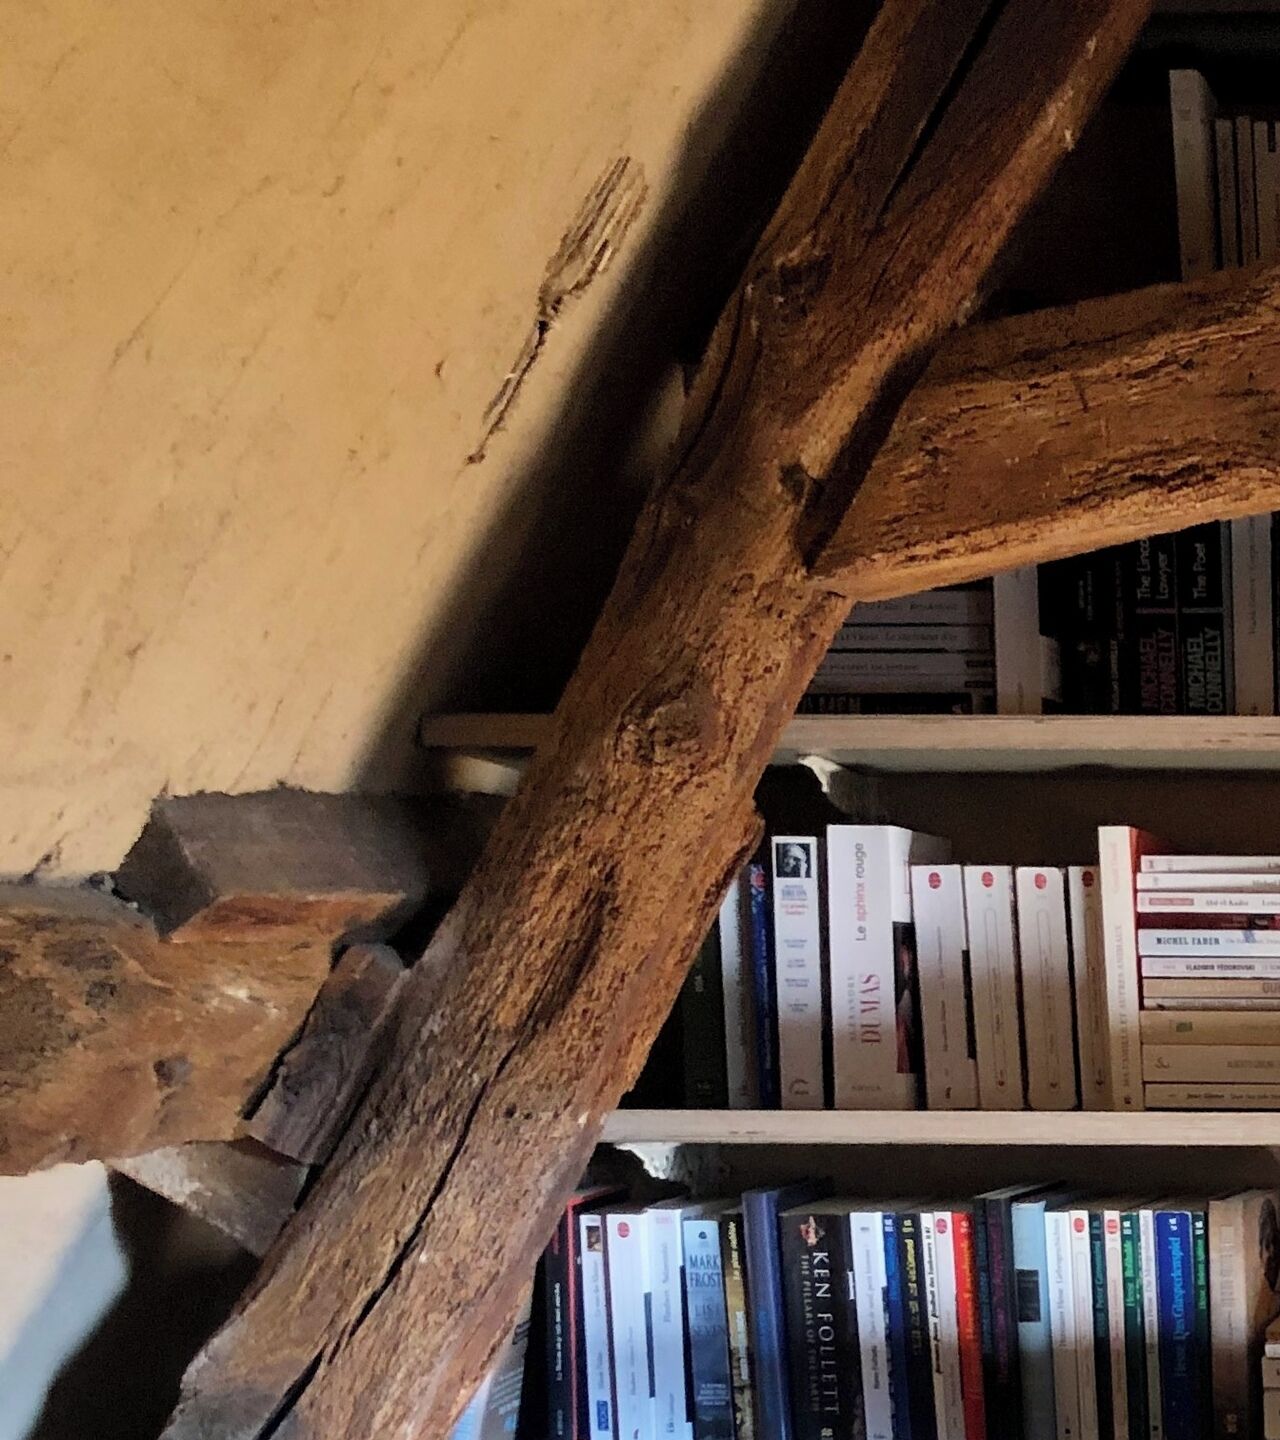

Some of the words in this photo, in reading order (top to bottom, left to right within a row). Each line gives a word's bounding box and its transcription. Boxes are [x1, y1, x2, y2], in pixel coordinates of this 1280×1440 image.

[1154, 552, 1171, 600] Lawyer
[1192, 576, 1207, 599] The
[1186, 633, 1206, 708] MICHAEL
[1203, 627, 1224, 712] CONNELLY
[853, 843, 866, 879] rouge
[855, 883, 868, 922] sphinx
[856, 926, 868, 942] Le
[1157, 938, 1189, 946] MICHEL
[1191, 938, 1220, 946] FABER
[860, 974, 881, 1044] DUMAS
[690, 1255, 720, 1269] MARK
[690, 1272, 722, 1288] FROST
[801, 1253, 812, 1277] THE
[813, 1251, 832, 1299] KEN
[1168, 1237, 1184, 1318] Glasperlenspiel
[802, 1281, 815, 1326] PILLARS
[817, 1311, 840, 1414] FOLLETT
